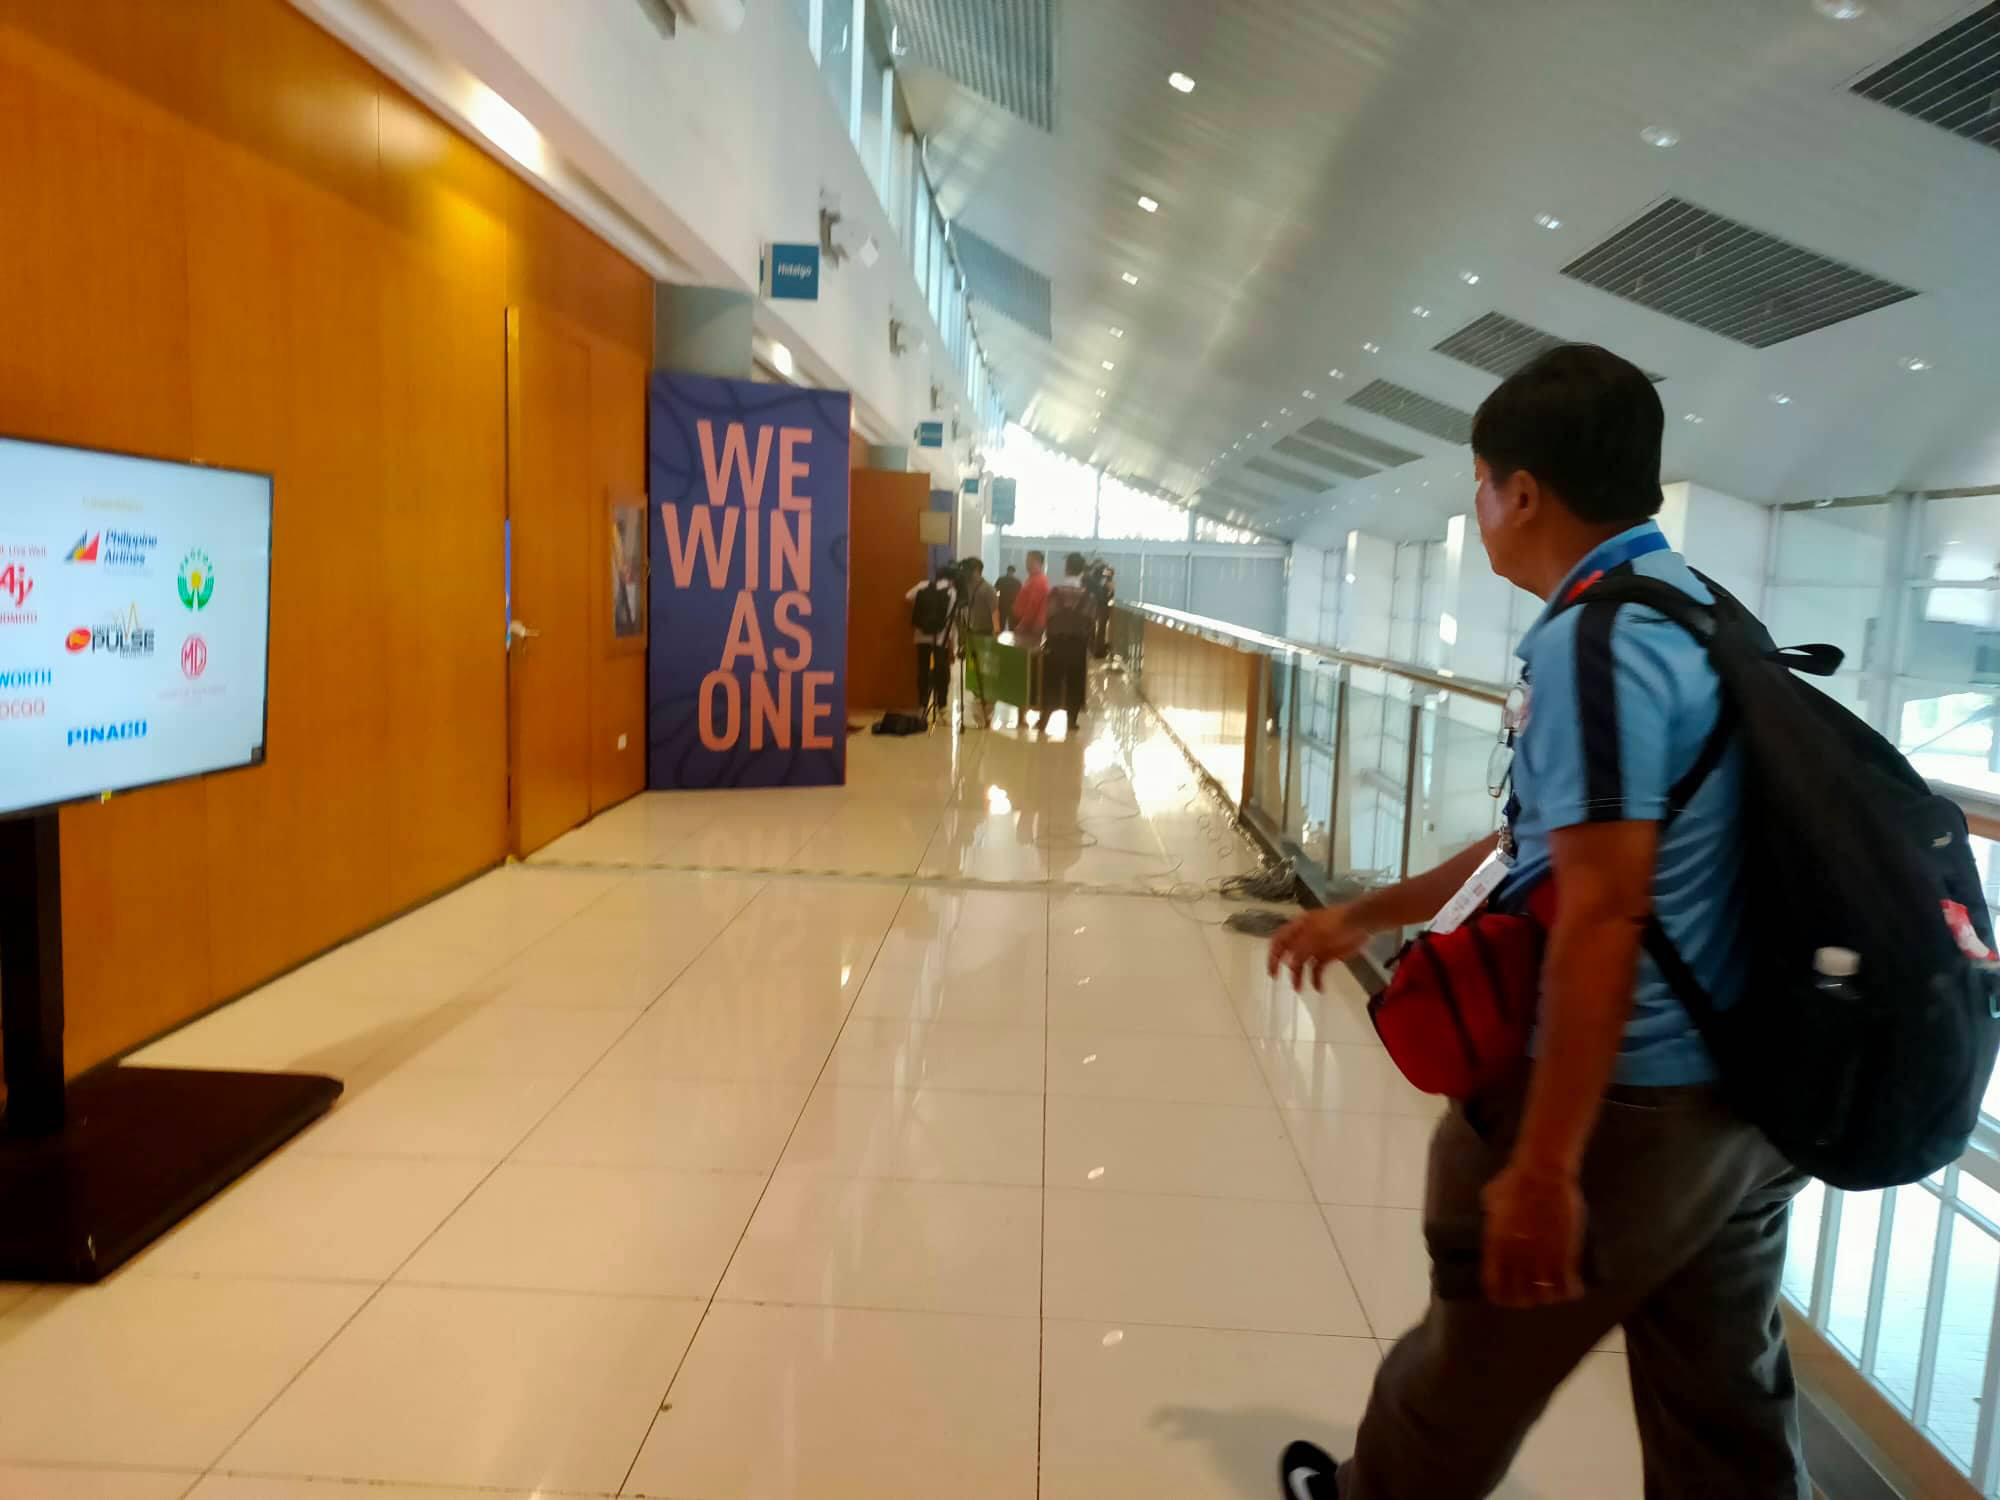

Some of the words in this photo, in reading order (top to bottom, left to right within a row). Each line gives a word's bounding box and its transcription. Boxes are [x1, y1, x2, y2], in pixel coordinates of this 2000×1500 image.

[696, 419, 813, 511] WE
[103, 548, 146, 566] Airlines
[661, 502, 812, 592] WIN
[718, 589, 813, 673] AS
[0, 668, 52, 689] WORTH
[698, 670, 835, 752] ONE
